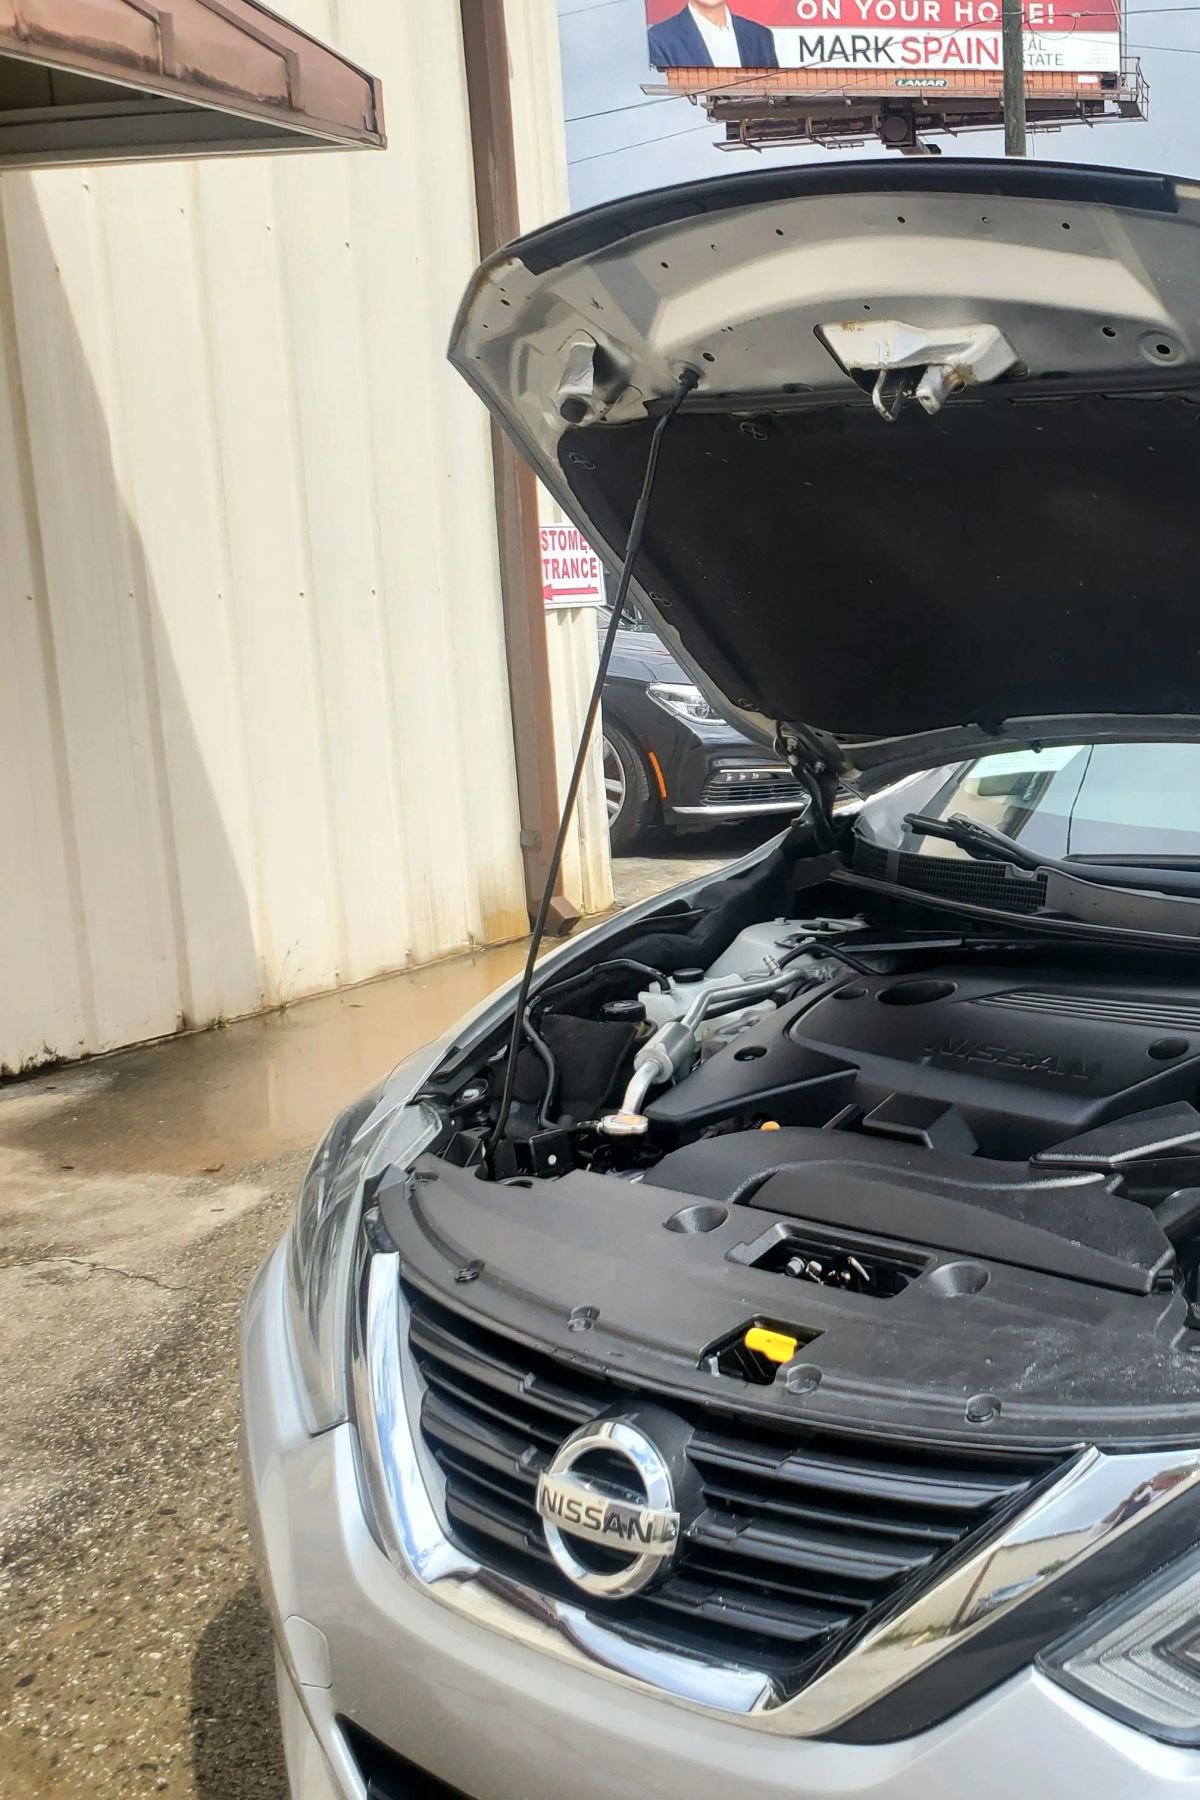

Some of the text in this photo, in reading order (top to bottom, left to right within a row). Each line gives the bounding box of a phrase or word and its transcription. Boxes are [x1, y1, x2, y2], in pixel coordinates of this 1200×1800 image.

[796, 0, 1056, 25] ON YOUR HOE!
[1023, 53, 1064, 66] TATE
[897, 79, 946, 87] LAMAR
[541, 530, 594, 551] STOME
[543, 557, 598, 579] TRANCE
[541, 1484, 651, 1543] NISSAN
